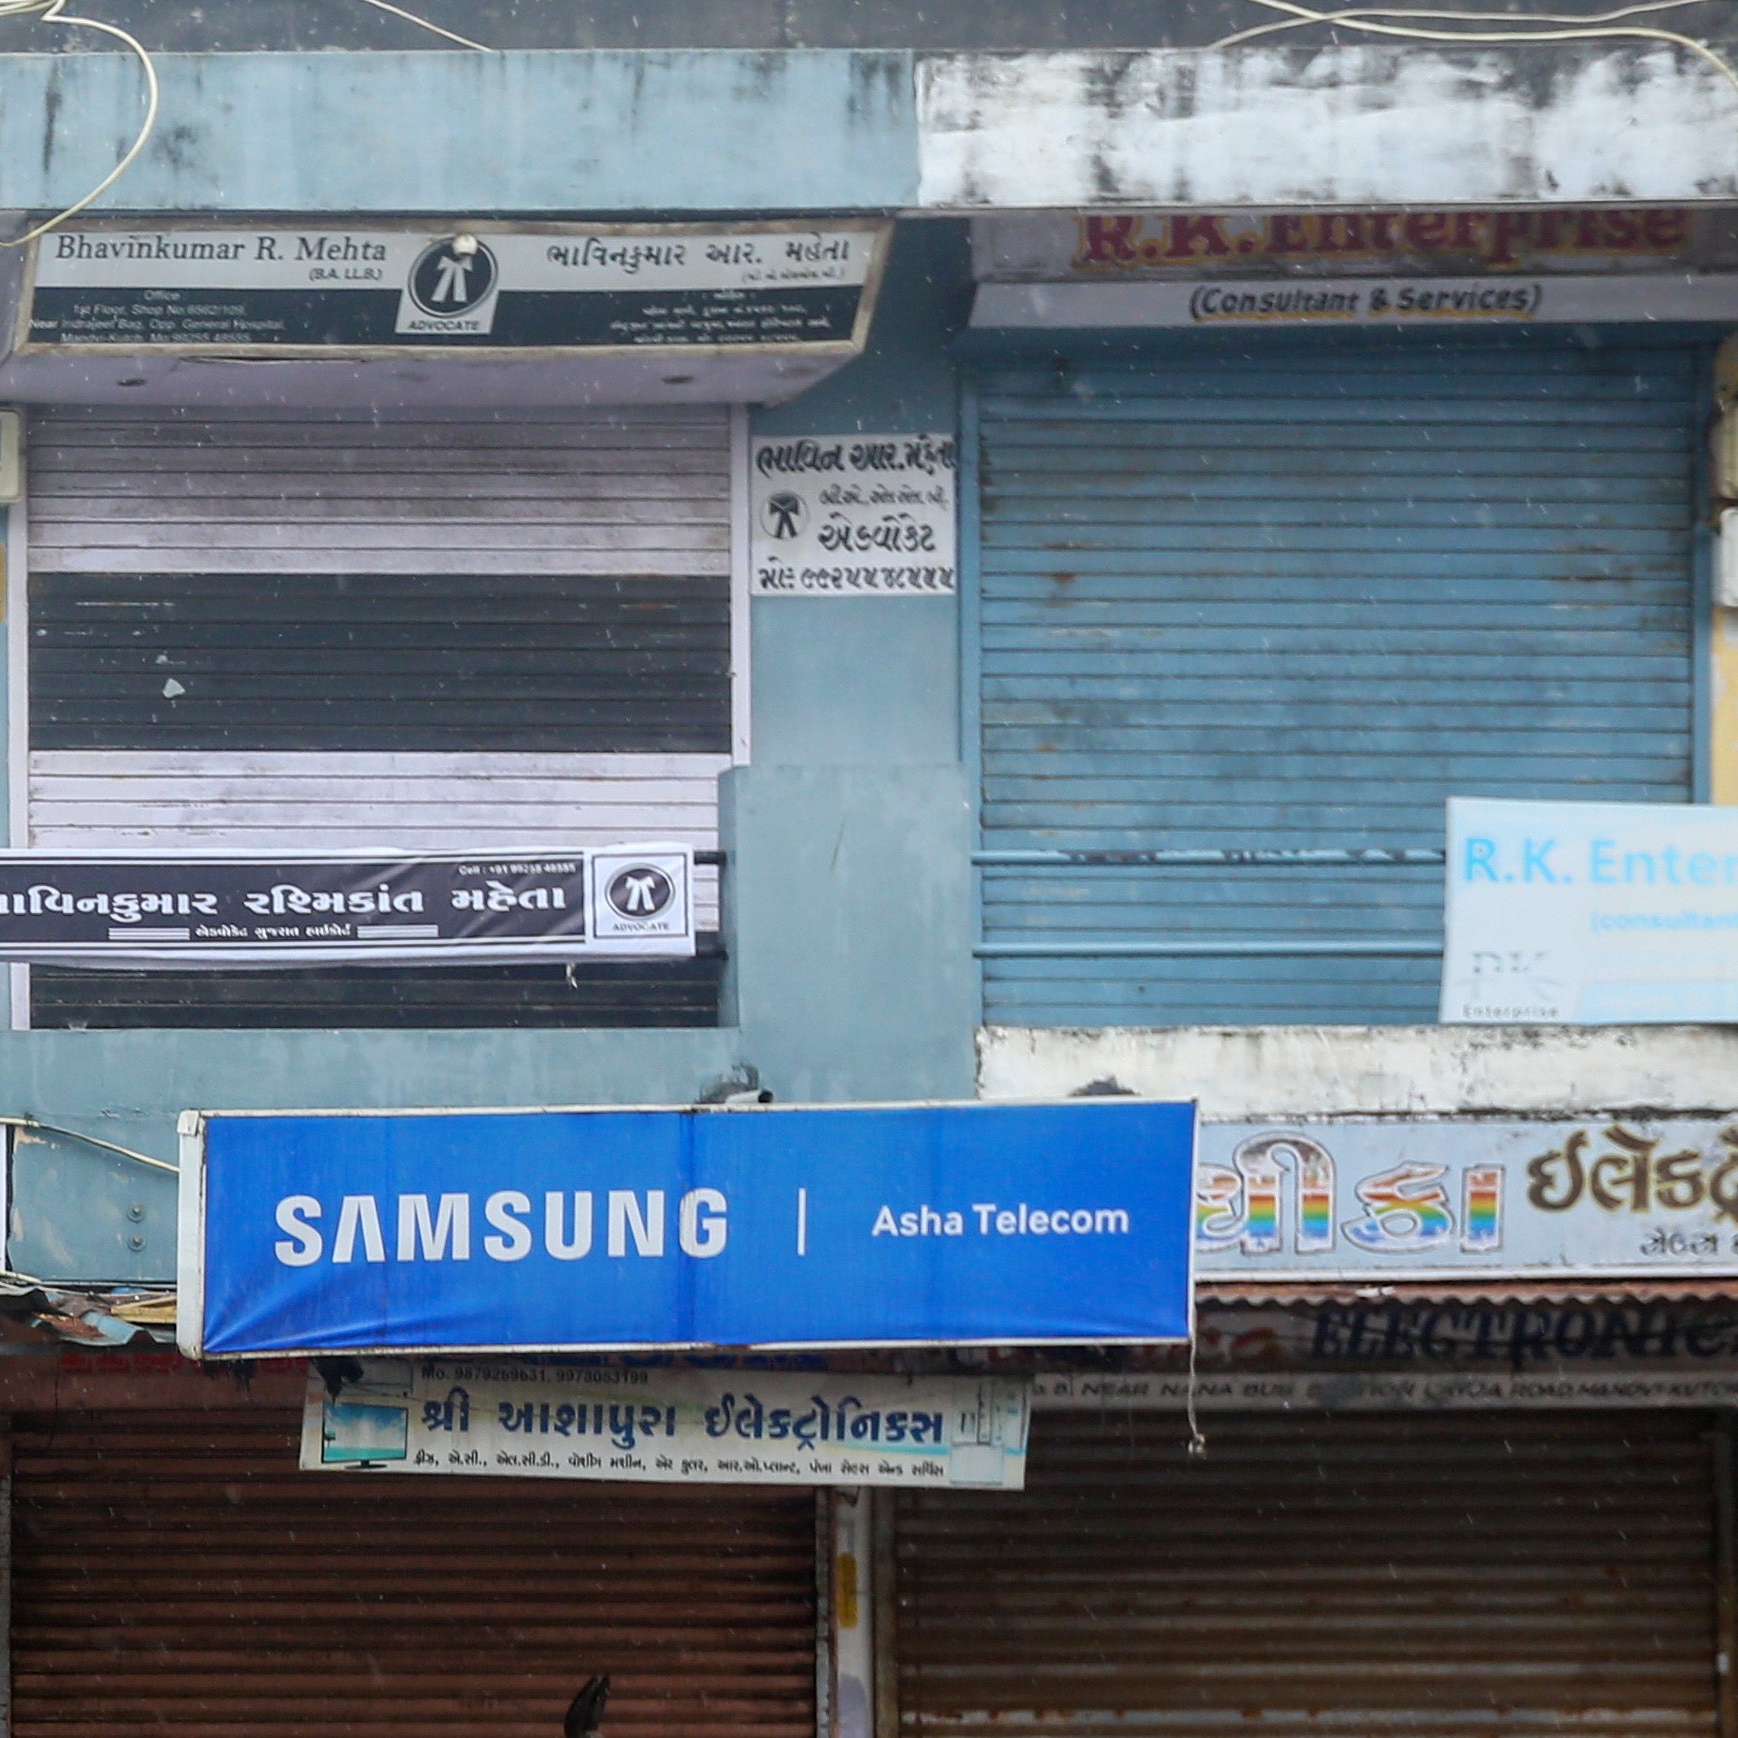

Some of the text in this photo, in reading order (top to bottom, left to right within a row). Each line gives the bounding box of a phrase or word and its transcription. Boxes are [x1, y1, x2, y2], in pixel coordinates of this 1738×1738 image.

[55, 234, 387, 265] Bhavinkumar R. Mehta
[546, 234, 850, 273] ભાવિનકુમાર આર. મહેતા
[1268, 209, 1691, 270] Enterprise
[1190, 285, 1542, 319] (Consultant & Services)
[409, 320, 480, 332] ADVOCATE
[756, 439, 845, 479] ભાવિન
[1464, 837, 1574, 885] R.K.
[243, 884, 425, 915] રશ્મિકાંત
[450, 880, 567, 911] મહેતા
[612, 922, 670, 933] ADVOCATE
[274, 1188, 1130, 1268] SAMSUNG Asha Telecom
[421, 1364, 449, 1380] Mo.
[420, 1387, 472, 1434] શ્રી
[498, 1399, 677, 1449] આશાપુરા
